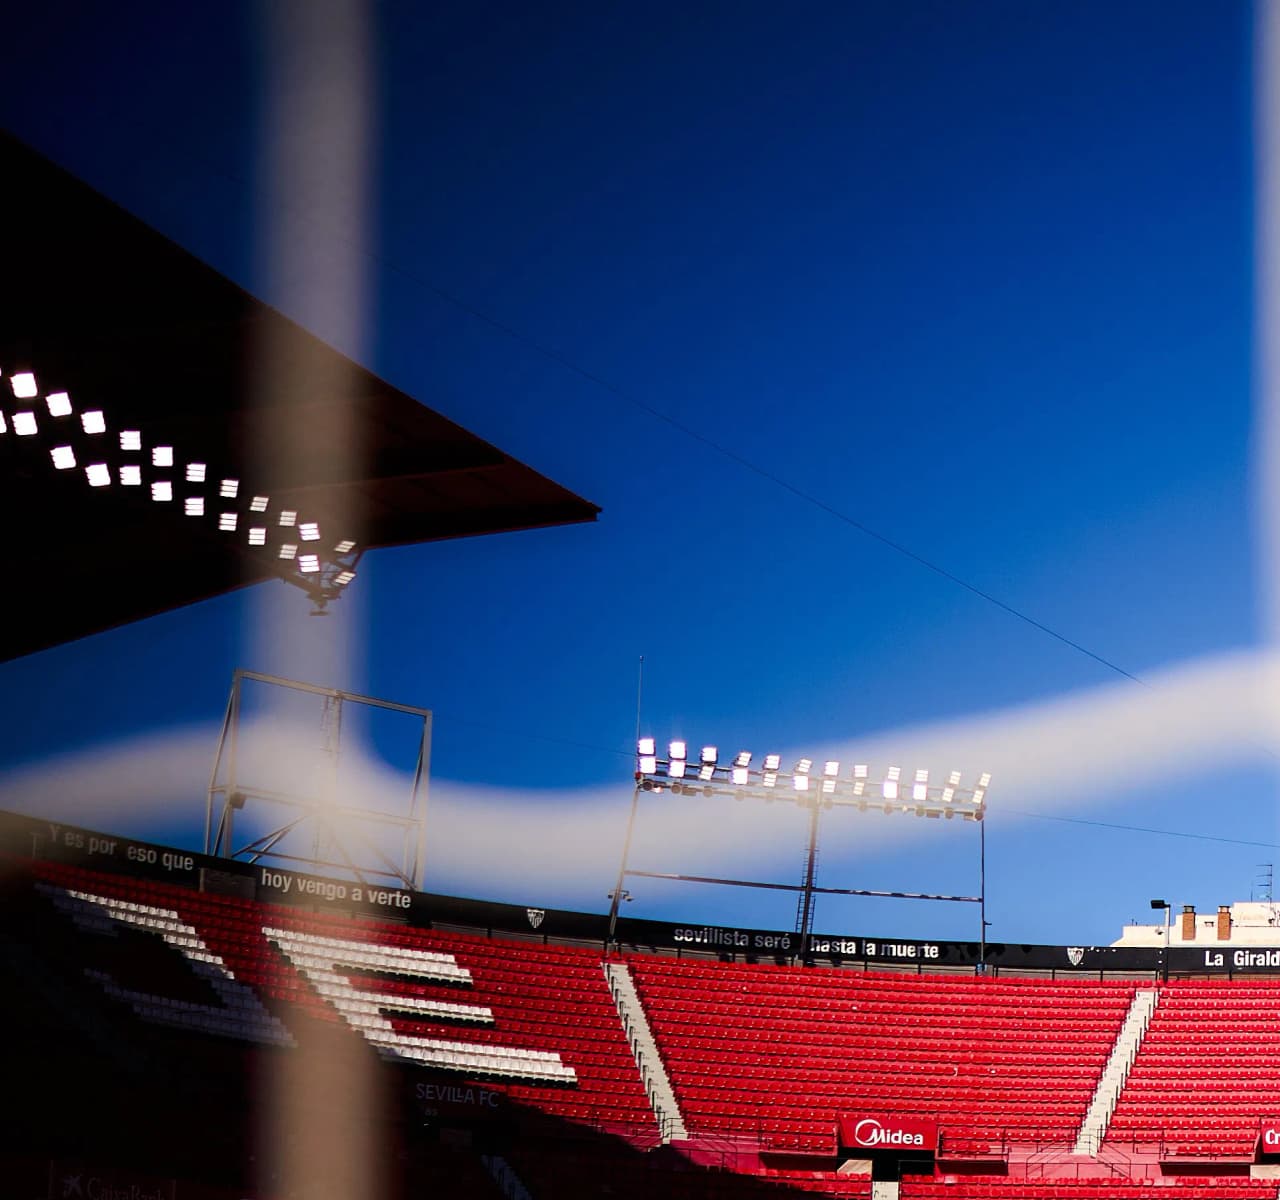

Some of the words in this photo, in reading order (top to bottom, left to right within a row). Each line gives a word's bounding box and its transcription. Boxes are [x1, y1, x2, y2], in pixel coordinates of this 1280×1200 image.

[64, 831, 84, 848] es
[88, 837, 117, 858] por
[127, 845, 158, 865] eso
[161, 852, 194, 872] que
[261, 869, 293, 894] hoy
[297, 878, 346, 901] vengo
[351, 887, 363, 903] a
[367, 889, 412, 910] verte
[674, 926, 749, 947] sevillista
[754, 933, 791, 950] seré
[810, 936, 856, 955] hasta
[862, 939, 876, 956] la
[882, 942, 939, 959] muerte
[1205, 950, 1224, 967] La
[860, 1122, 924, 1146] Midea
